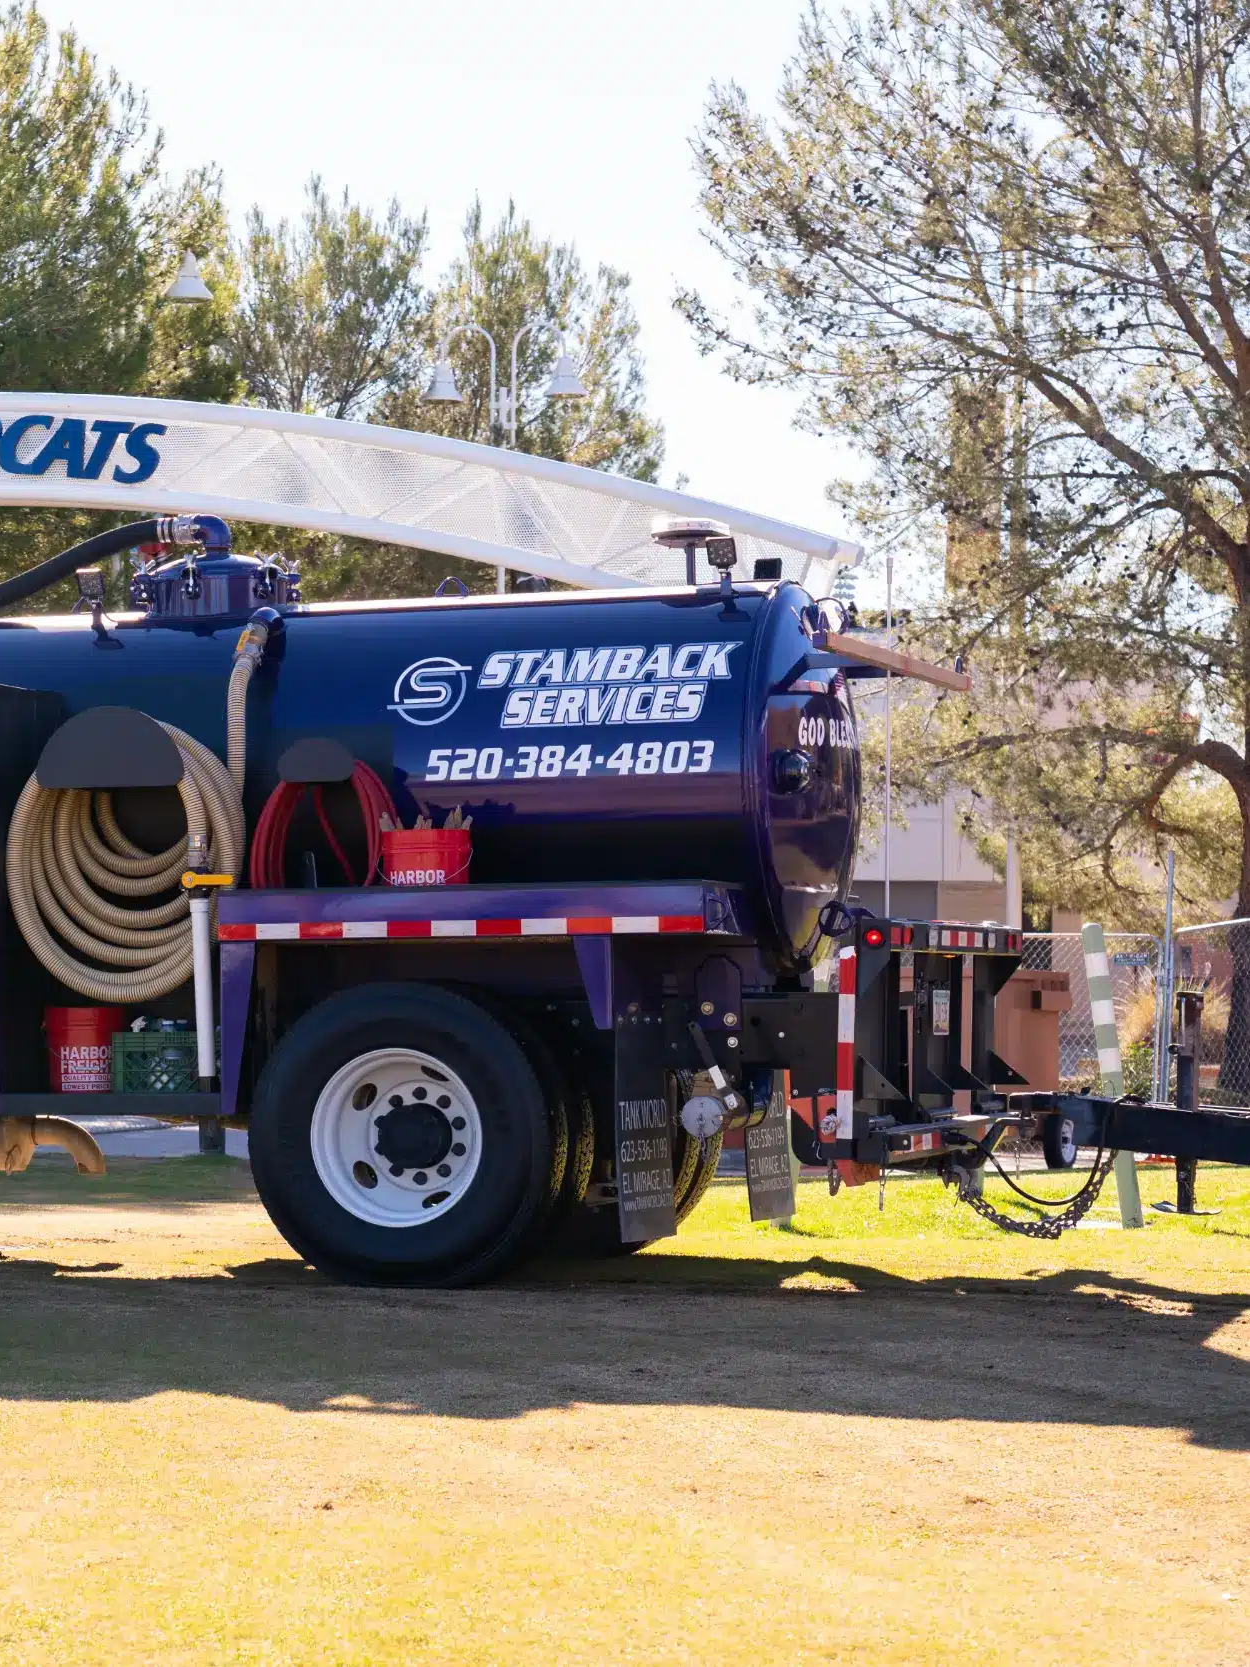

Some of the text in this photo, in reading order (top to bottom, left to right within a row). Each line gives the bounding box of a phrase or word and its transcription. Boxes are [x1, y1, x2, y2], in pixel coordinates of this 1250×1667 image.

[477, 641, 743, 689] STAMBACK
[499, 682, 708, 728] SERVICES
[798, 716, 825, 747] GOD
[390, 869, 446, 884] HARBOR
[620, 1138, 667, 1162] 623-536-1199
[622, 1172, 632, 1194] EL
[663, 1167, 672, 1189] AZ
[750, 1159, 759, 1178] EL
